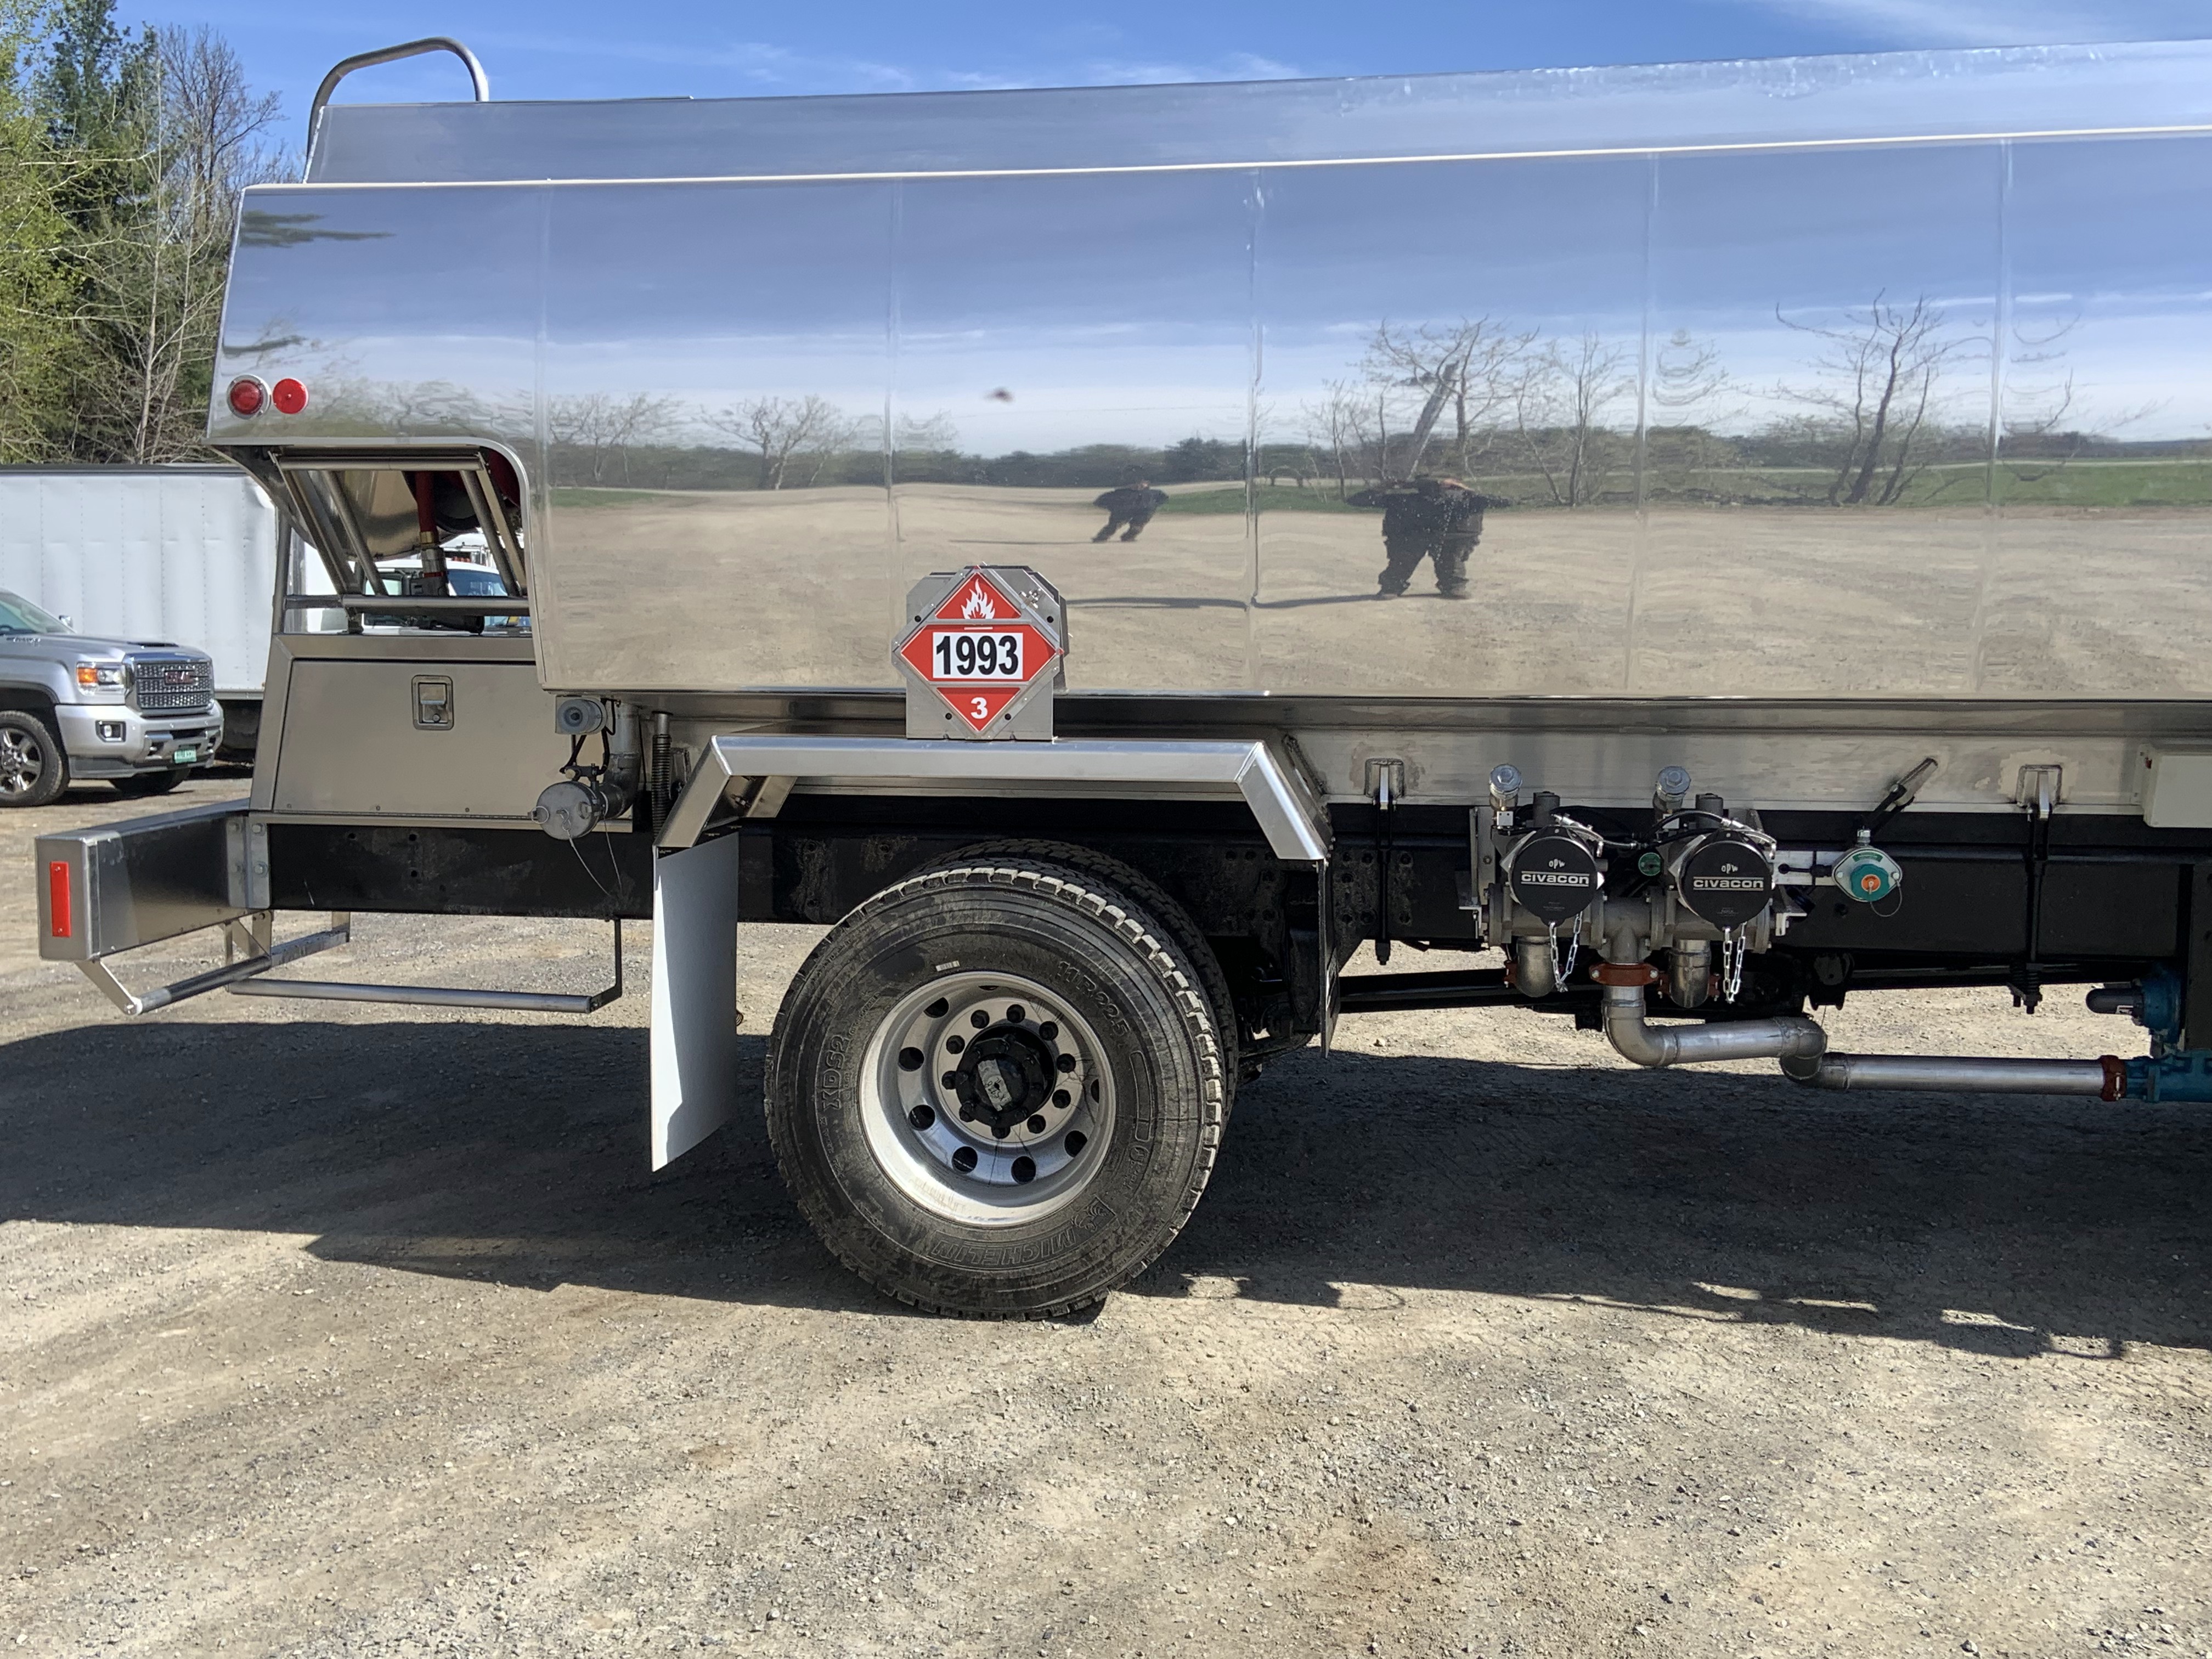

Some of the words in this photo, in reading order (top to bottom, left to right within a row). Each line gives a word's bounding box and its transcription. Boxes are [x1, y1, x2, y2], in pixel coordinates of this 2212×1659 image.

[936, 635, 1019, 675] 1993
[970, 697, 988, 719] 3
[932, 1227, 1077, 1266] MICHELIN
